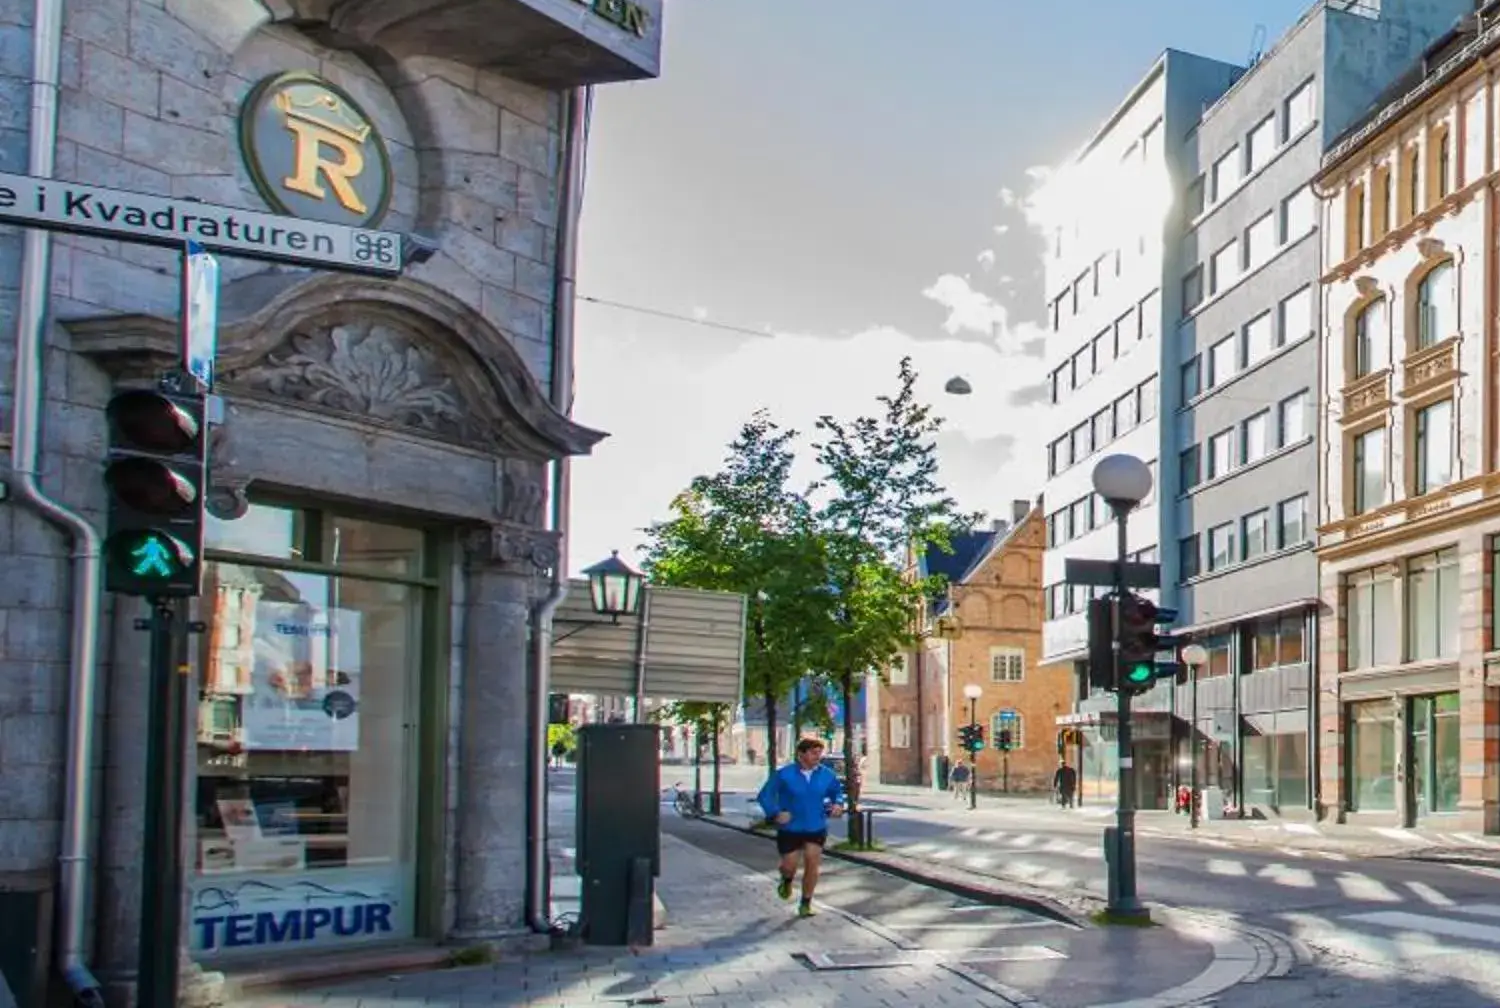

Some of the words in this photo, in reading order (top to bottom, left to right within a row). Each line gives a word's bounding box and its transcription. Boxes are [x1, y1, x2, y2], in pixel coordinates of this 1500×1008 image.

[284, 114, 367, 215] R
[37, 185, 46, 212] i
[65, 190, 335, 254] Kvadraturen
[193, 903, 393, 950] TEMPUR
